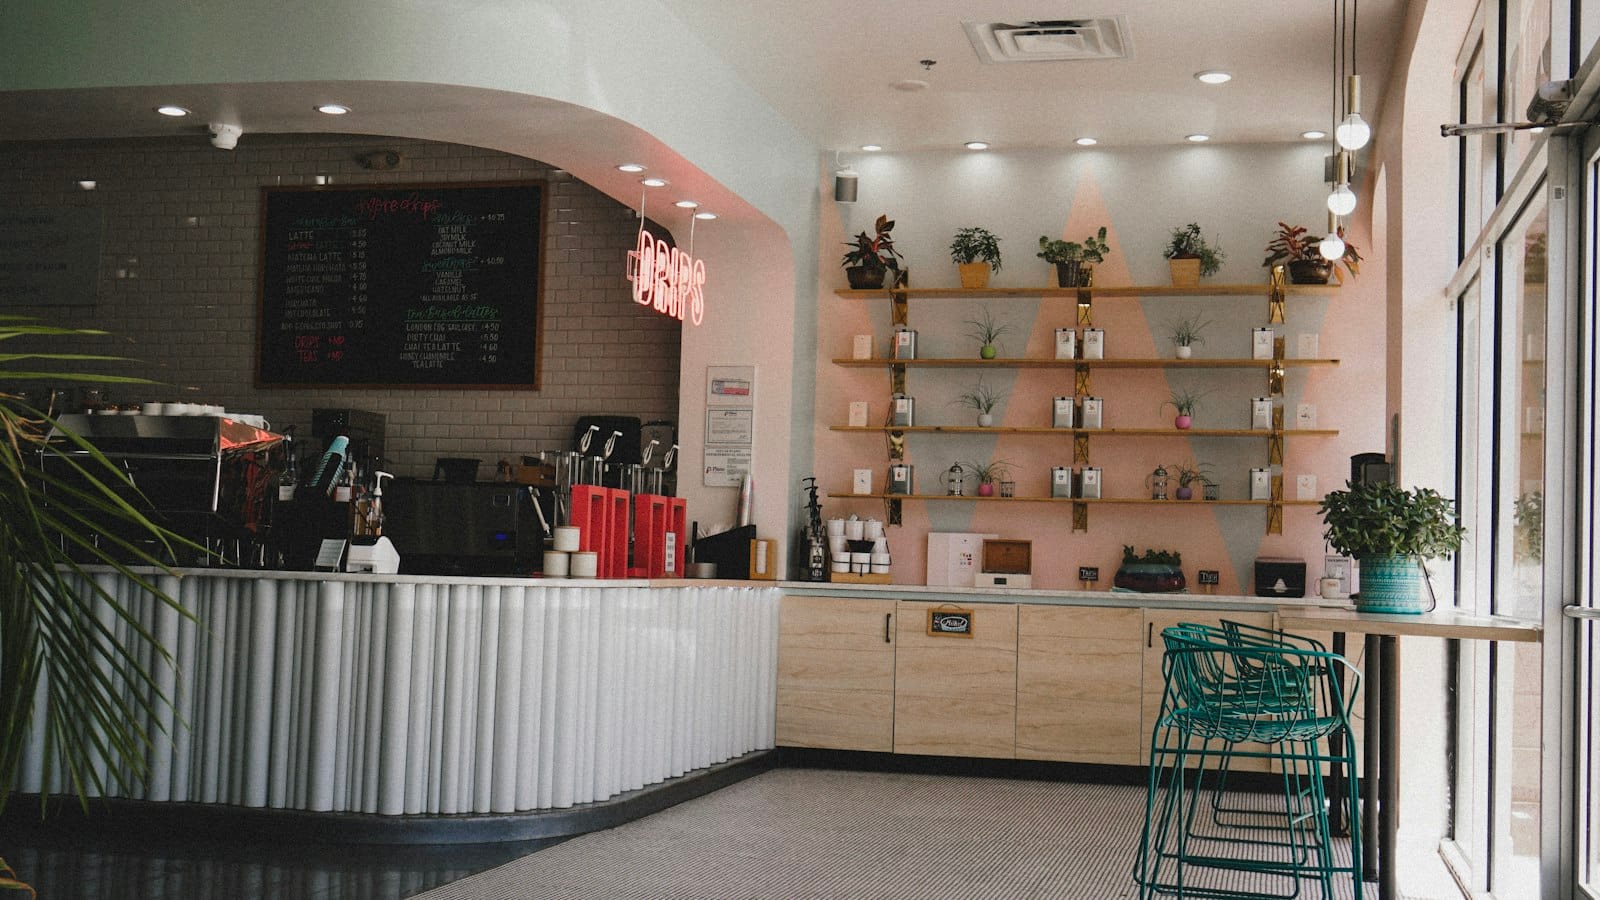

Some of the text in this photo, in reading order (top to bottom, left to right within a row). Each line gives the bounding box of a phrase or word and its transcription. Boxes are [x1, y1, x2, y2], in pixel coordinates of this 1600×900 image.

[288, 230, 314, 241] LATTE
[459, 239, 477, 248] MILK
[319, 251, 342, 262] LATTE
[637, 230, 706, 326] DRIPS
[406, 333, 429, 342] DIRTY
[403, 343, 420, 352] CHAI
[422, 343, 436, 352] TEA
[437, 342, 462, 352] LATTE
[424, 360, 444, 369] LATTE
